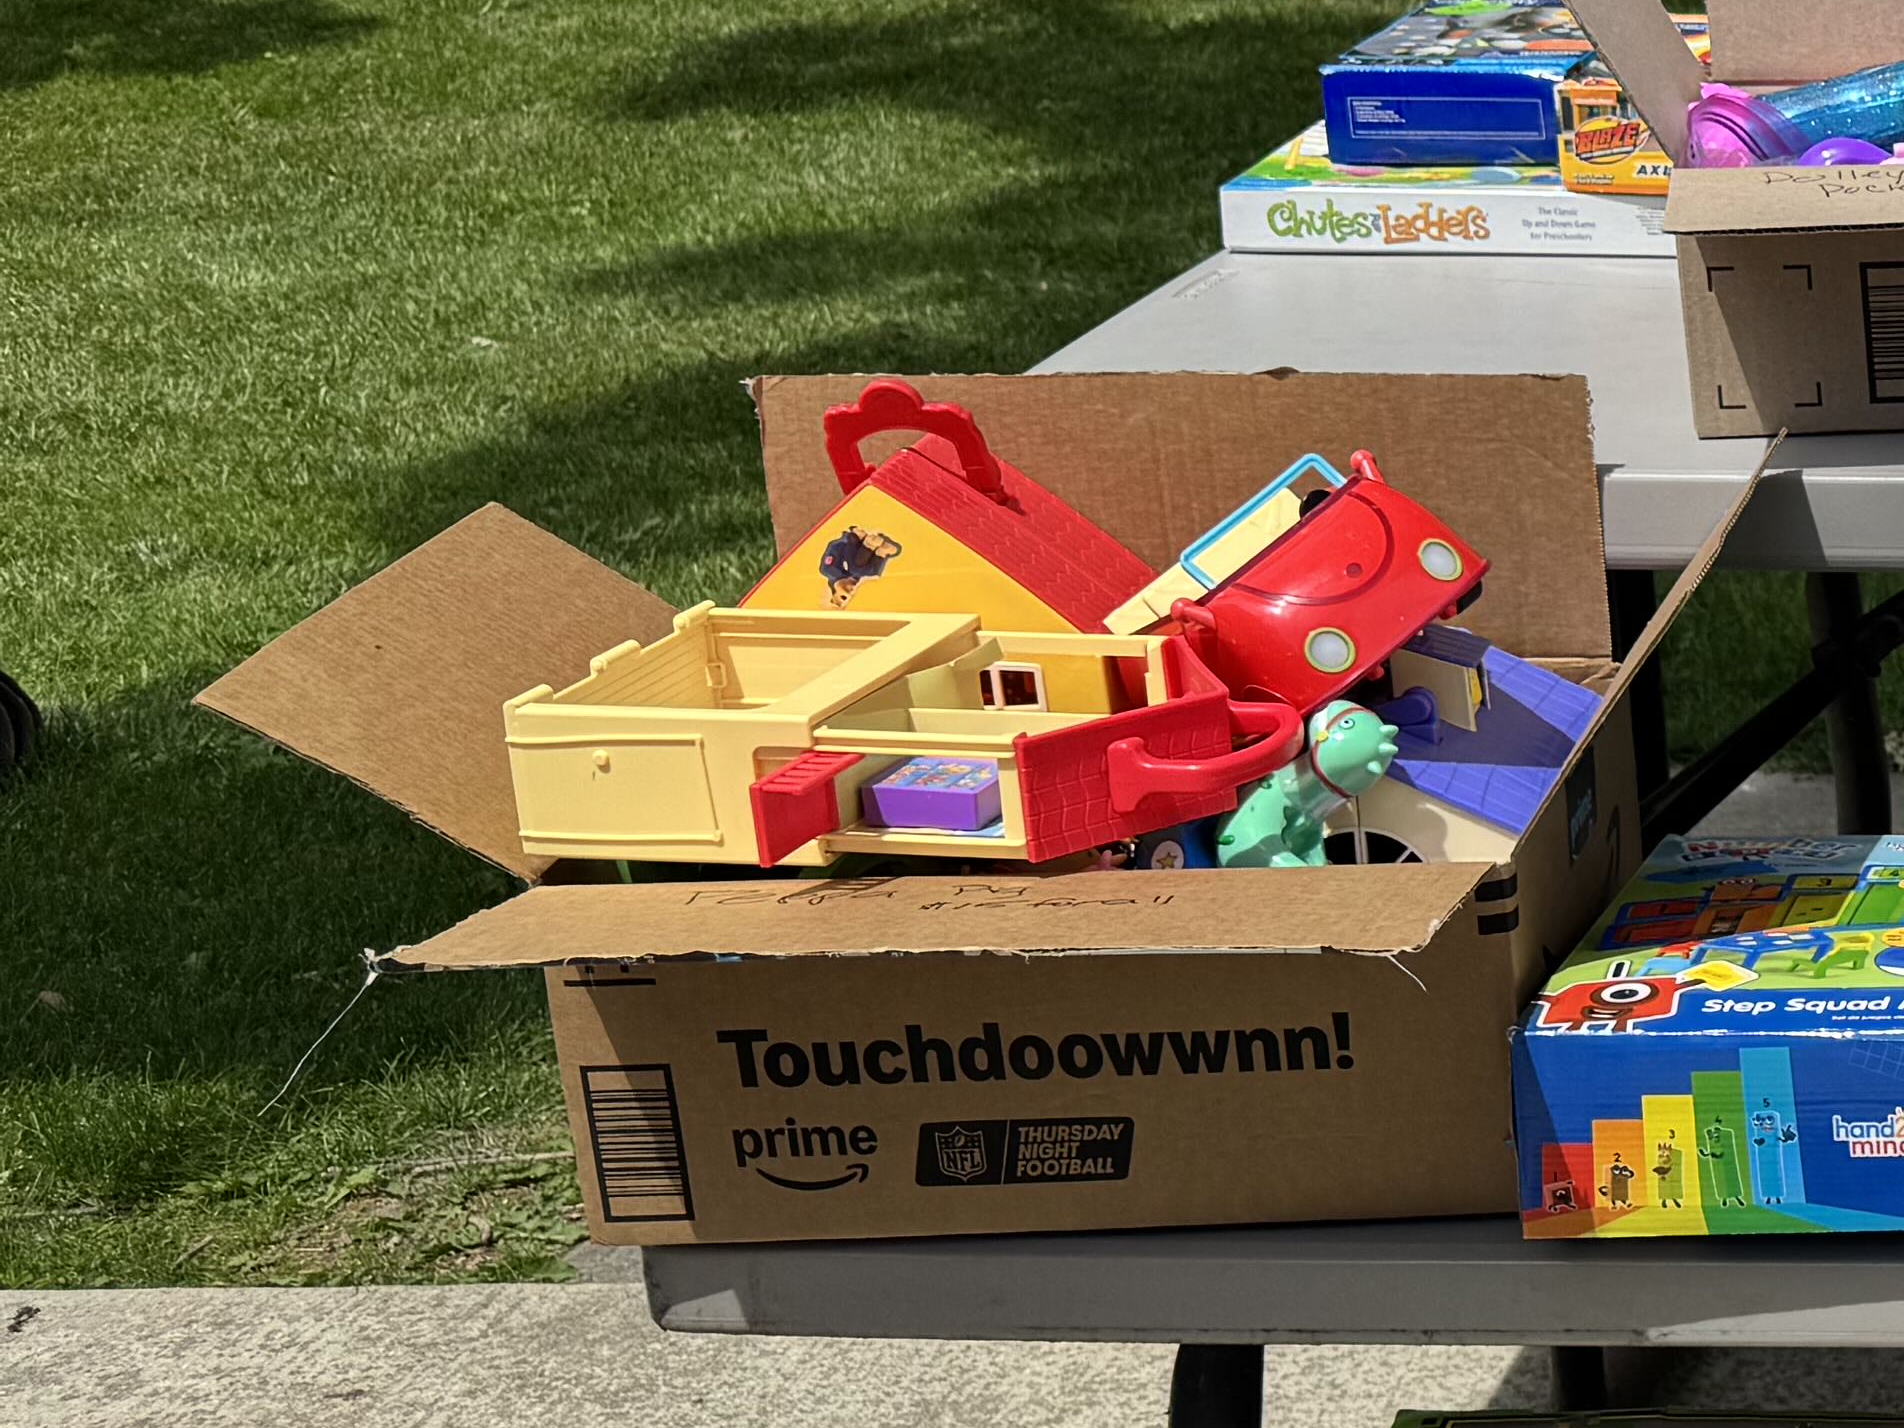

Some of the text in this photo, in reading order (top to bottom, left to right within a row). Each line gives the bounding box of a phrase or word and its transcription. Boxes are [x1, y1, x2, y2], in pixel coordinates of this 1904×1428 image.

[1575, 123, 1640, 156] BLAZE
[1636, 165, 1672, 176] AXL
[1538, 206, 1552, 216] The
[1267, 199, 1375, 243] Chutes
[1376, 202, 1490, 244] Ladders
[1537, 219, 1549, 229] and
[1551, 219, 1573, 229] Down
[1574, 219, 1597, 229] Game
[1701, 998, 1775, 1015] Step
[1784, 996, 1890, 1015] Squad
[716, 1011, 1354, 1088] Touchdoowwnn!
[1763, 1097, 1771, 1108] 5
[733, 1117, 877, 1168] prime
[1017, 1123, 1125, 1144] THURSDAY
[1668, 1129, 1676, 1140] 3
[1017, 1140, 1080, 1160] NIGHT
[1613, 1152, 1622, 1163] 2
[944, 1148, 980, 1173] NFL
[1017, 1156, 1116, 1176] FOOTBALL
